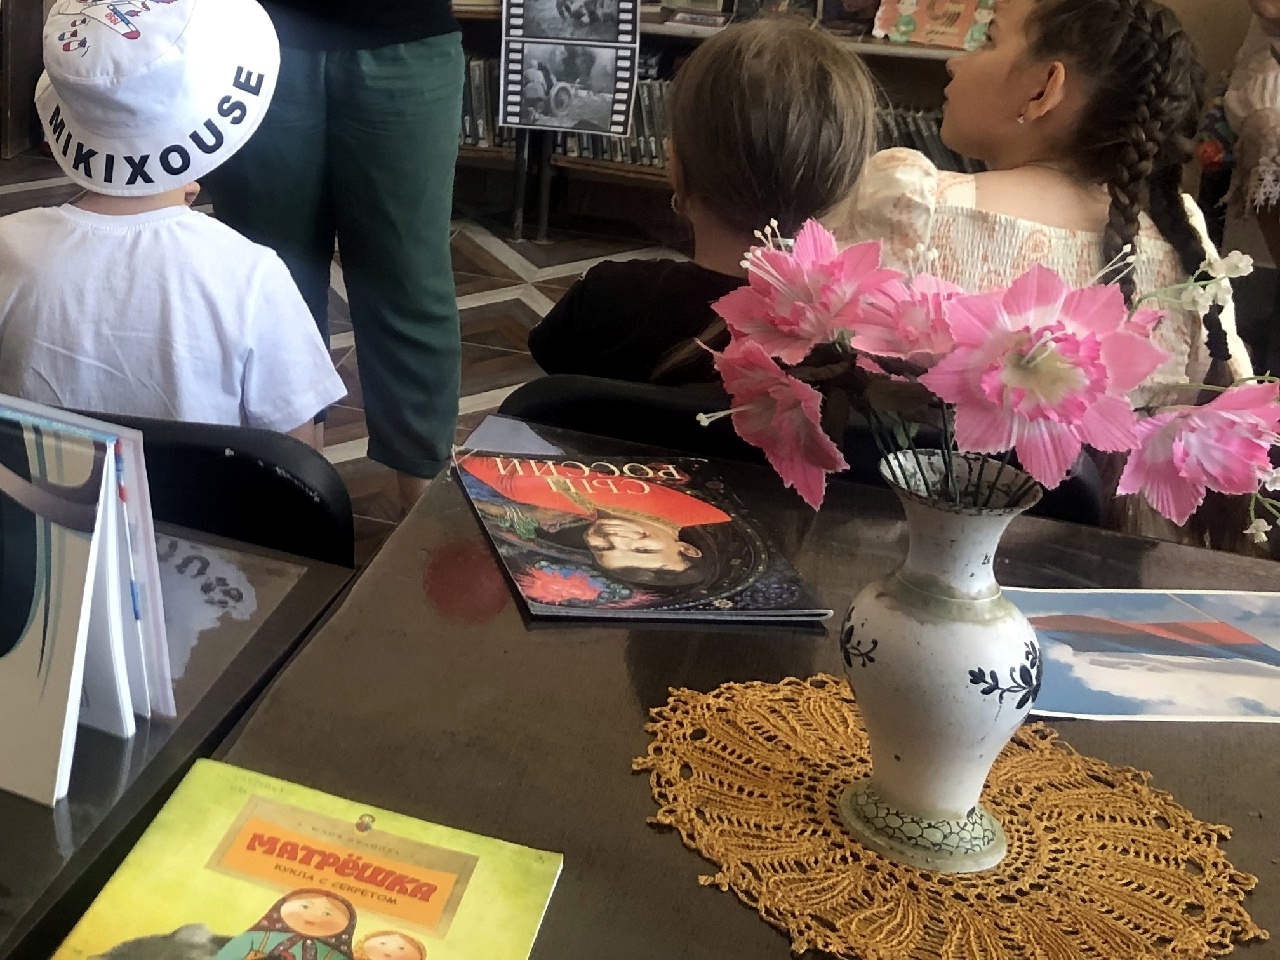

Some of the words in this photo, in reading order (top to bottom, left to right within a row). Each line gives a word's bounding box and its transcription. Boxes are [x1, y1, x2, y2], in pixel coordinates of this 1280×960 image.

[49, 65, 265, 185] MIKIXOUSE
[494, 456, 683, 481] РОССИИ
[274, 862, 314, 882] КУКЛА
[319, 876, 328, 885] С
[331, 881, 397, 906] СЕКРЕТОМ
